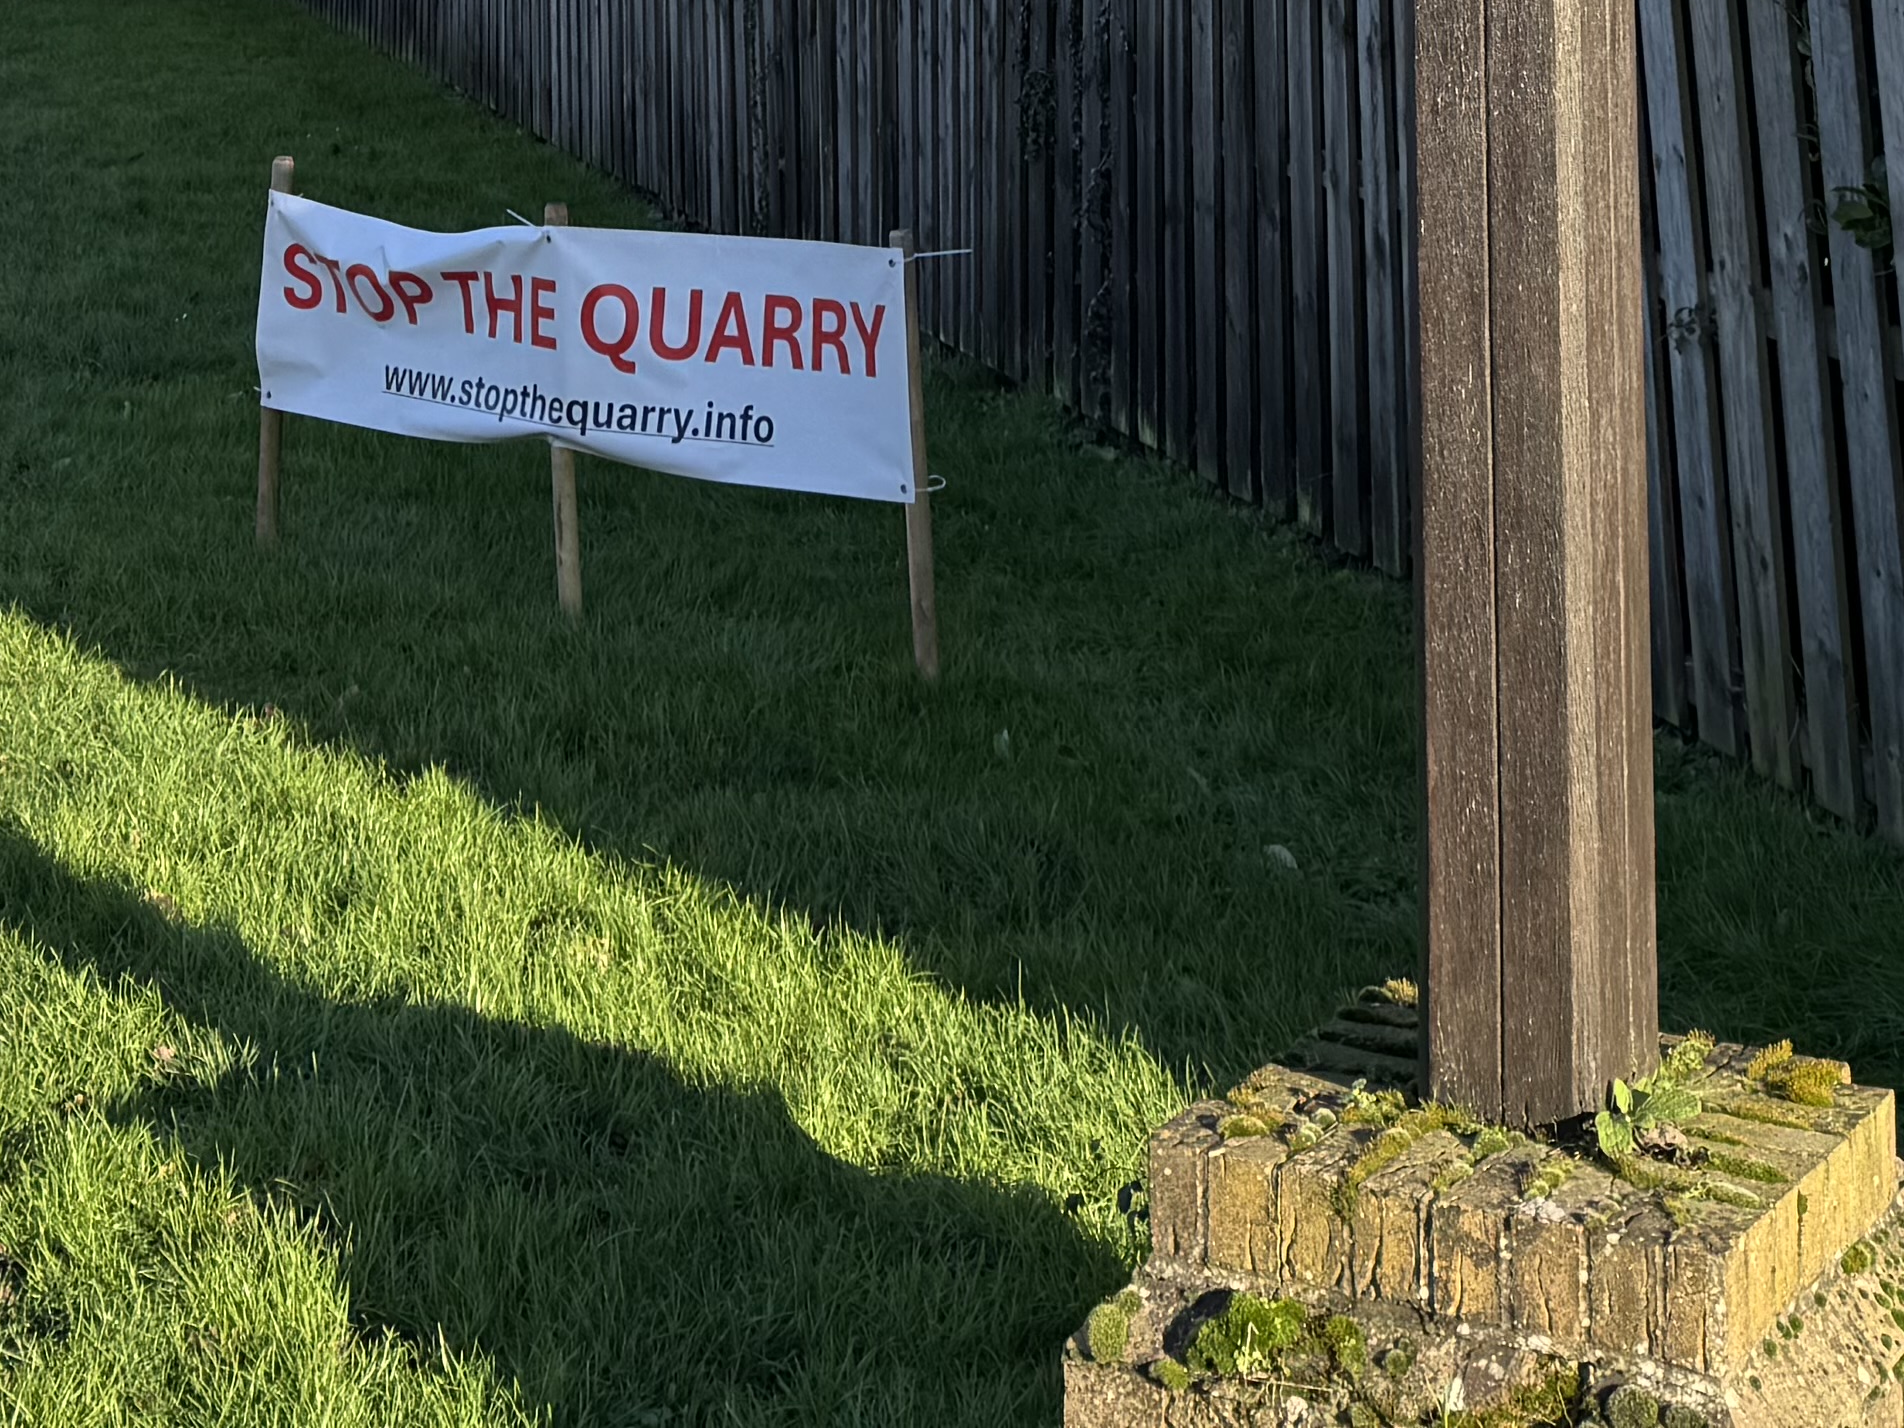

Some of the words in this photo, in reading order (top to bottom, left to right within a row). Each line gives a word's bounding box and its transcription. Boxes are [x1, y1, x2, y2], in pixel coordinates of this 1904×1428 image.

[283, 243, 433, 325] STOP
[442, 271, 557, 350] THE
[580, 284, 886, 378] QUARRY
[384, 364, 775, 444] www.stopthequarry.info
